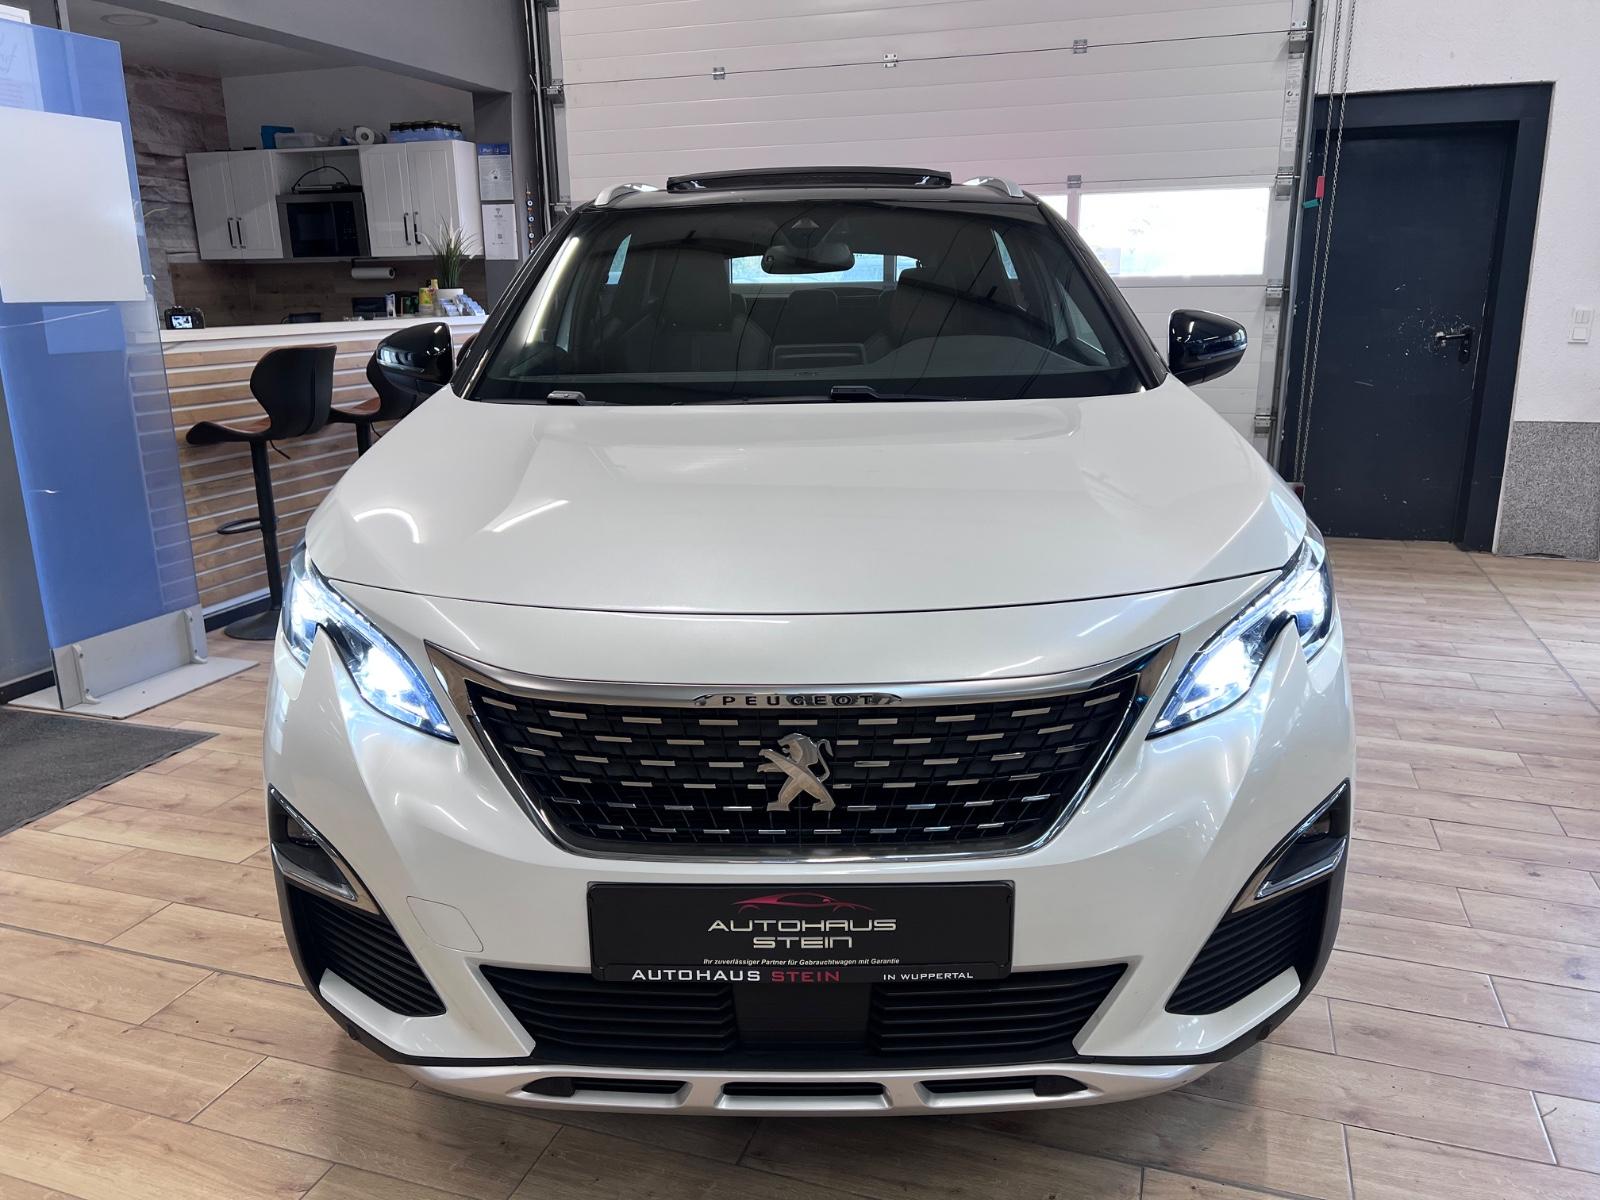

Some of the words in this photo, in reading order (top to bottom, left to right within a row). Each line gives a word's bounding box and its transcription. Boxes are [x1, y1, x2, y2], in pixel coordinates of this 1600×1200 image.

[722, 695, 874, 706] PEUGEOT
[707, 919, 897, 932] AUTOHAUS
[752, 936, 852, 949] STEIN
[714, 957, 760, 967] zuverlässiger
[761, 958, 786, 966] Partner
[787, 958, 798, 966] für
[799, 957, 857, 967] Gebrauchtwagen
[871, 957, 900, 965] Garantie
[631, 969, 761, 981] AUTOHAUS
[771, 970, 840, 982] STEIN
[883, 973, 896, 981] IN
[900, 972, 974, 980] WUPPERTAL
